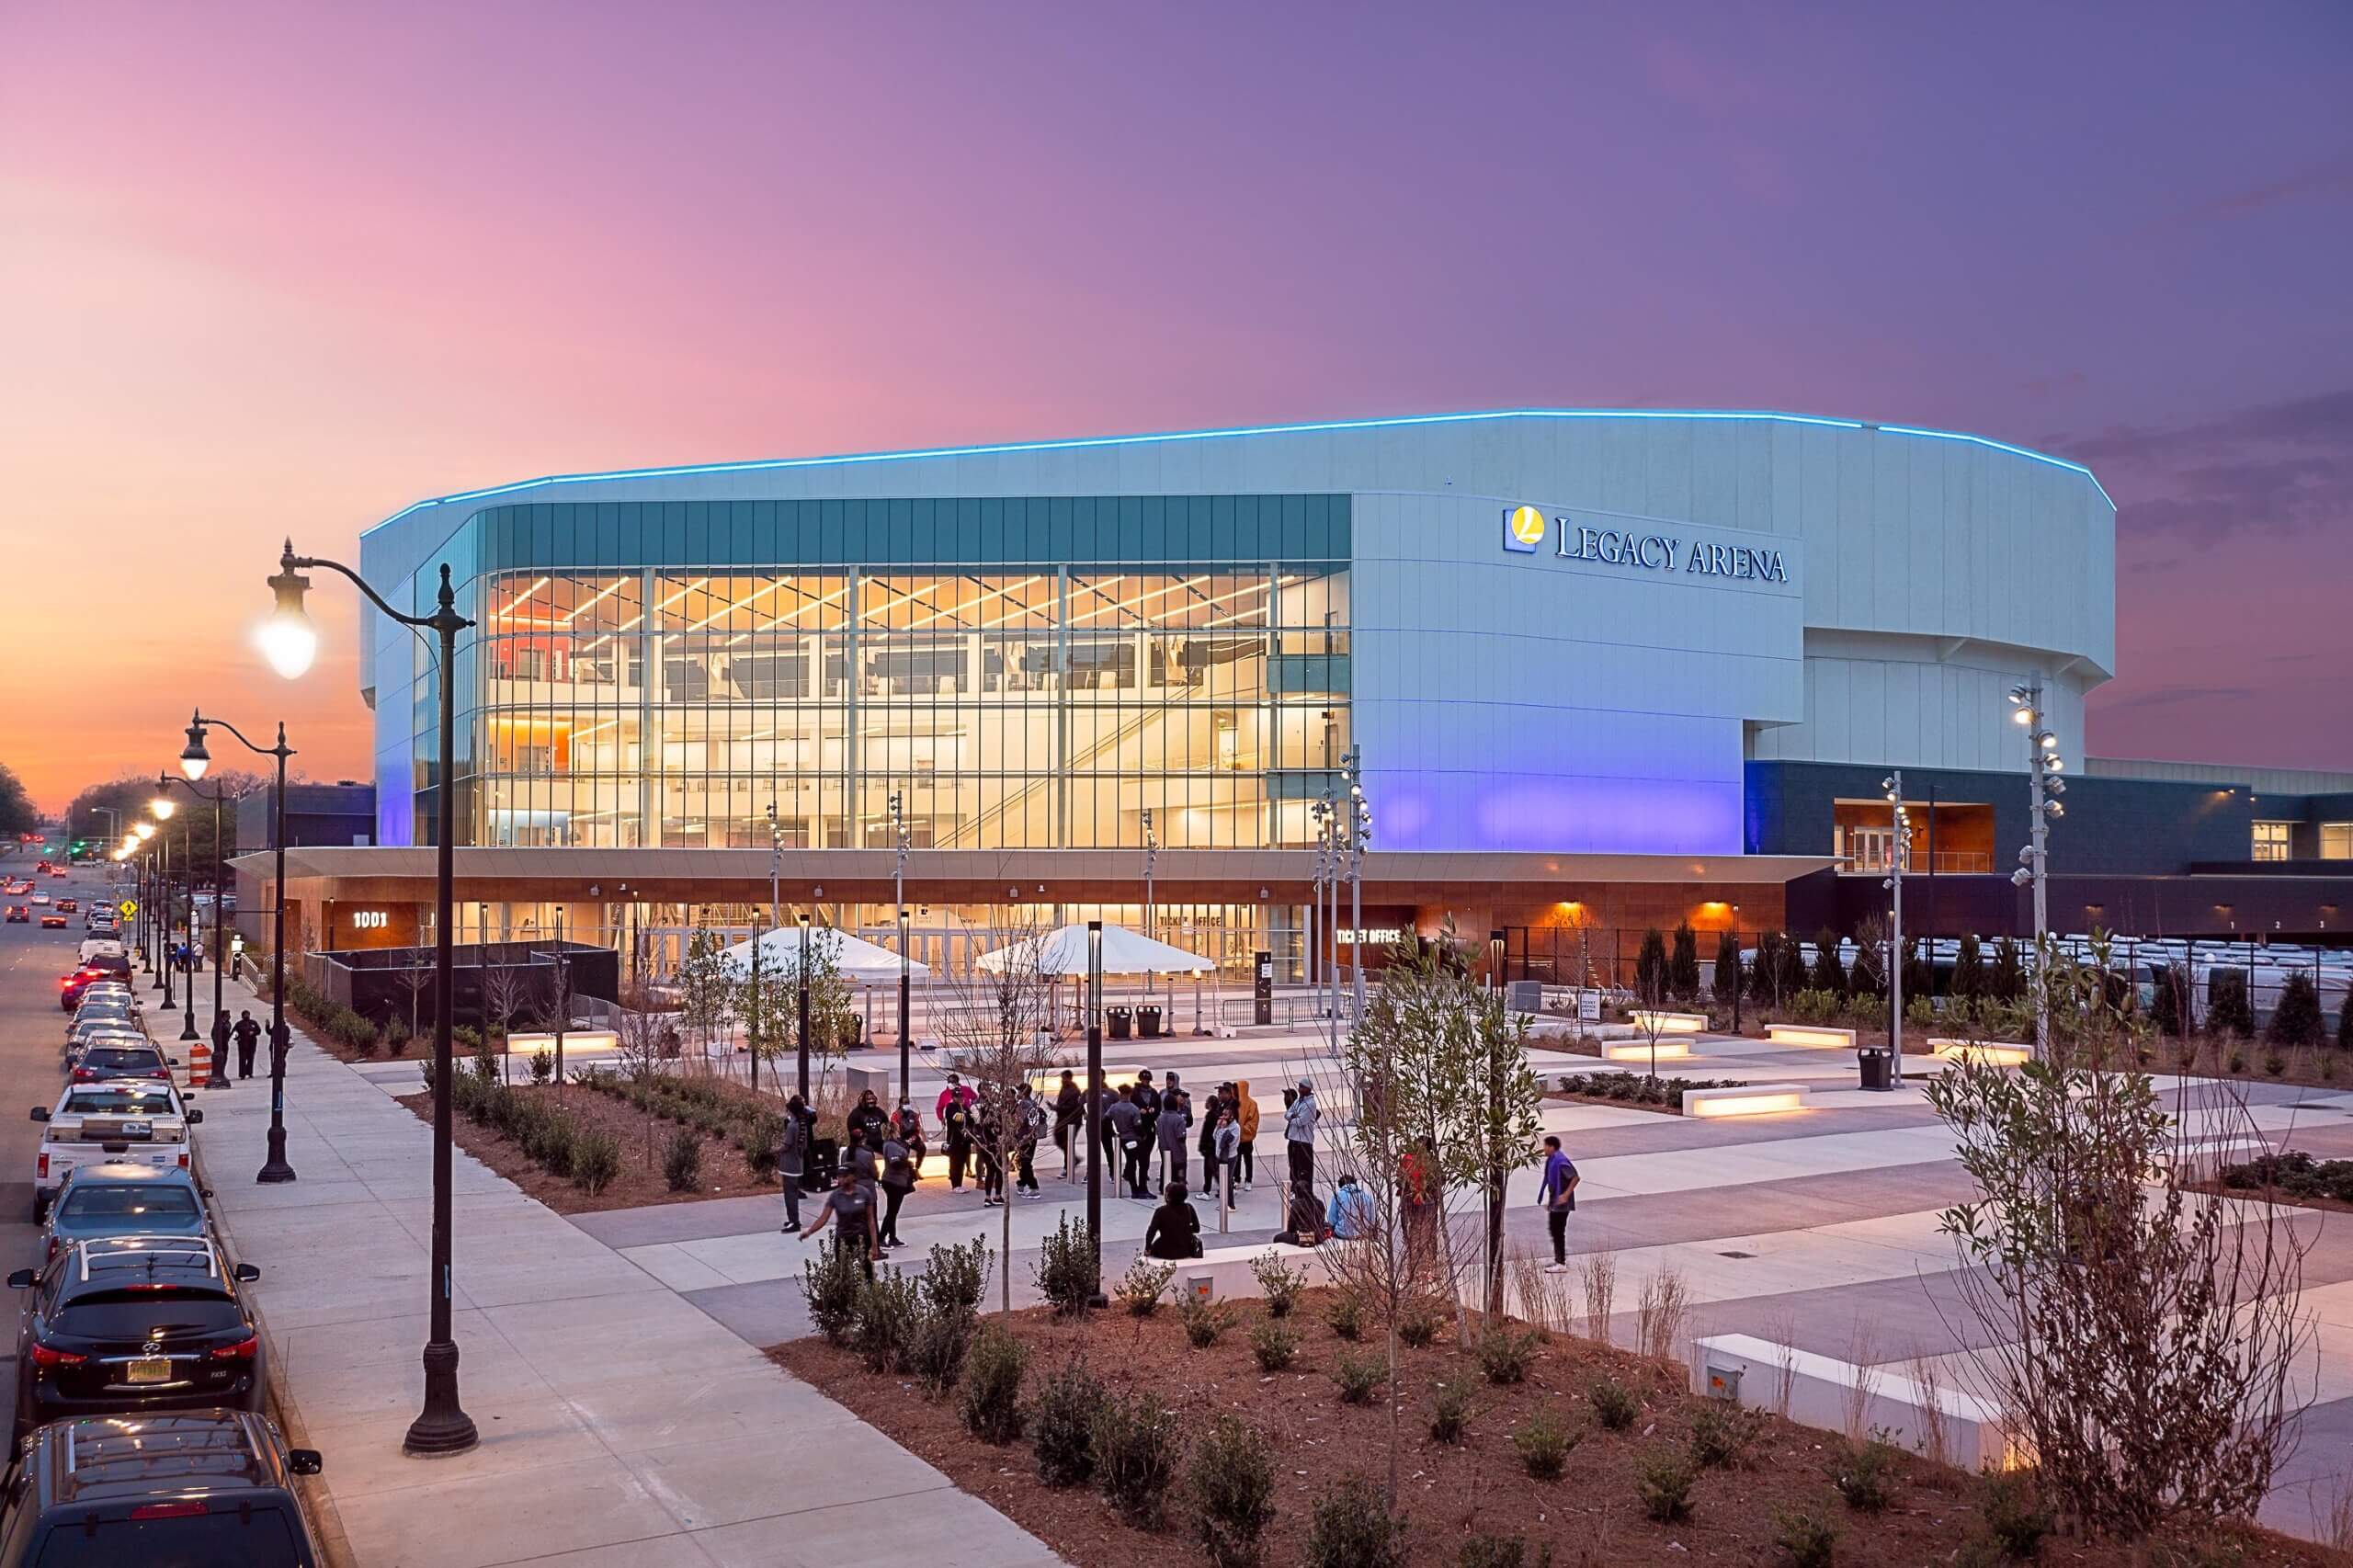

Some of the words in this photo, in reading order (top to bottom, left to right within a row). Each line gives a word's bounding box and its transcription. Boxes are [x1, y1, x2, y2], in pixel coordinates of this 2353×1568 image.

[1555, 516, 1682, 571] LEGACY
[1687, 540, 1789, 583] ARENA
[353, 911, 387, 928] 1001
[1194, 916, 1221, 926] OFFCE
[2230, 921, 2234, 929] 1
[2275, 921, 2280, 929] 2
[1369, 929, 1402, 944] OFFICE
